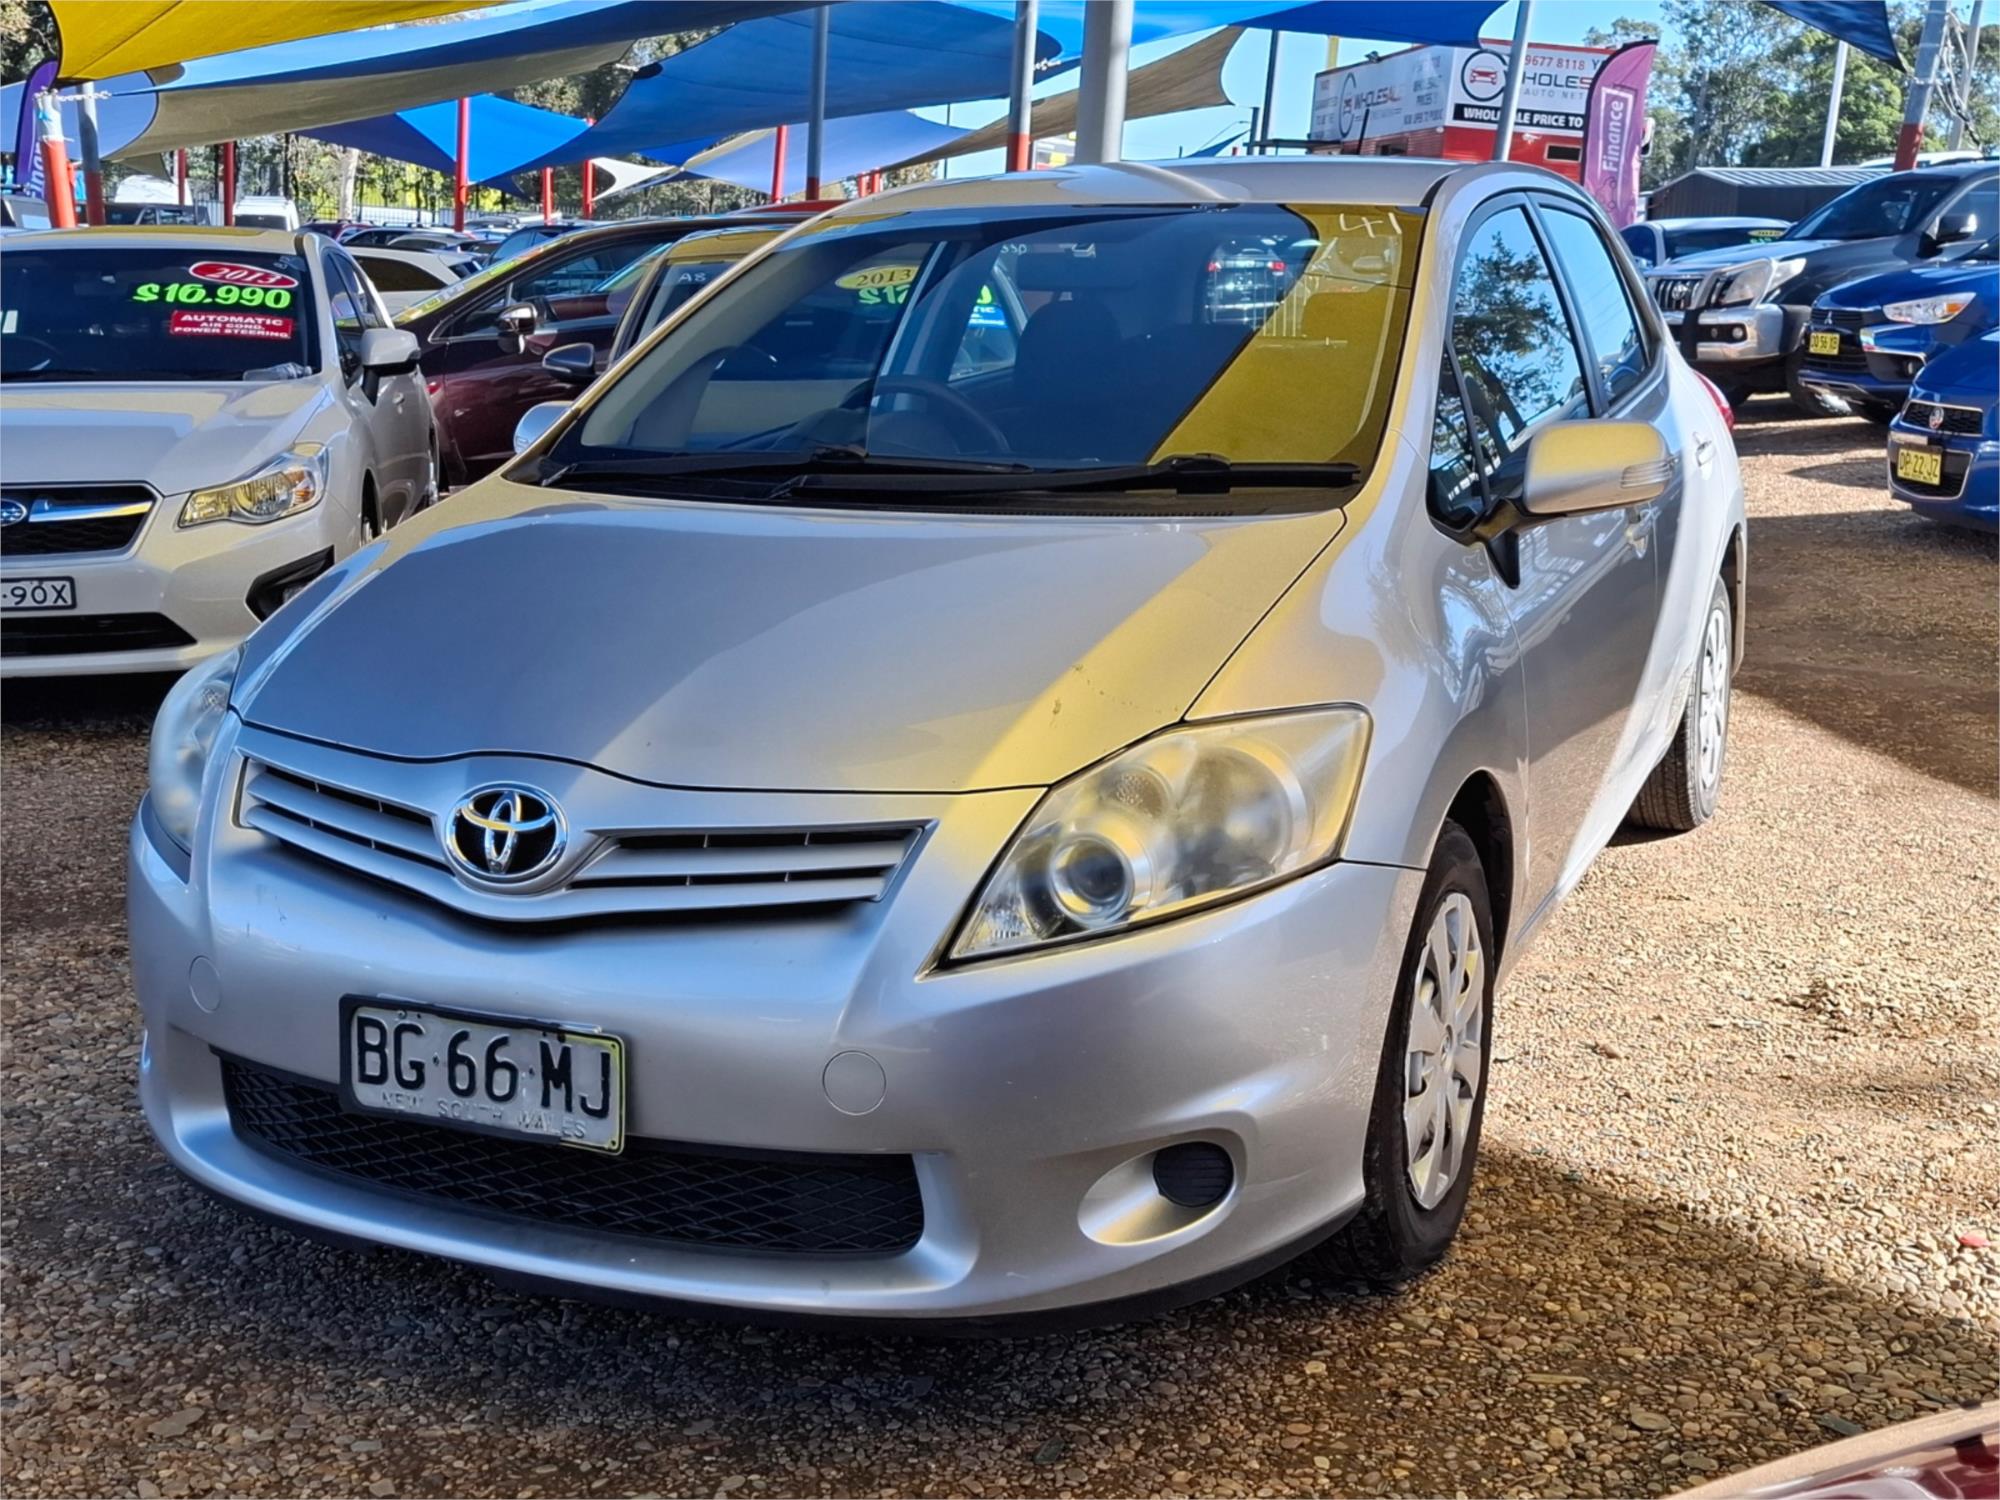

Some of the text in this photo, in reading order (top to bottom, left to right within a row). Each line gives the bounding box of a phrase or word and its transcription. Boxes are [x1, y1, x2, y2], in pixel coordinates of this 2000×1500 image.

[1521, 71, 1594, 90] HOLES
[1523, 88, 1556, 98] AUTO
[1532, 113, 1566, 126] PRICE
[1568, 116, 1584, 128] TO
[1602, 100, 1625, 172] Finance
[1339, 211, 1402, 239] 41
[204, 267, 283, 285] 2013
[856, 267, 912, 287] 2013
[180, 313, 284, 327] AUTOMATIC
[199, 321, 223, 329] AIR
[174, 326, 222, 335] POWER
[382, 1091, 586, 1139] NEW SOUTH WALES
